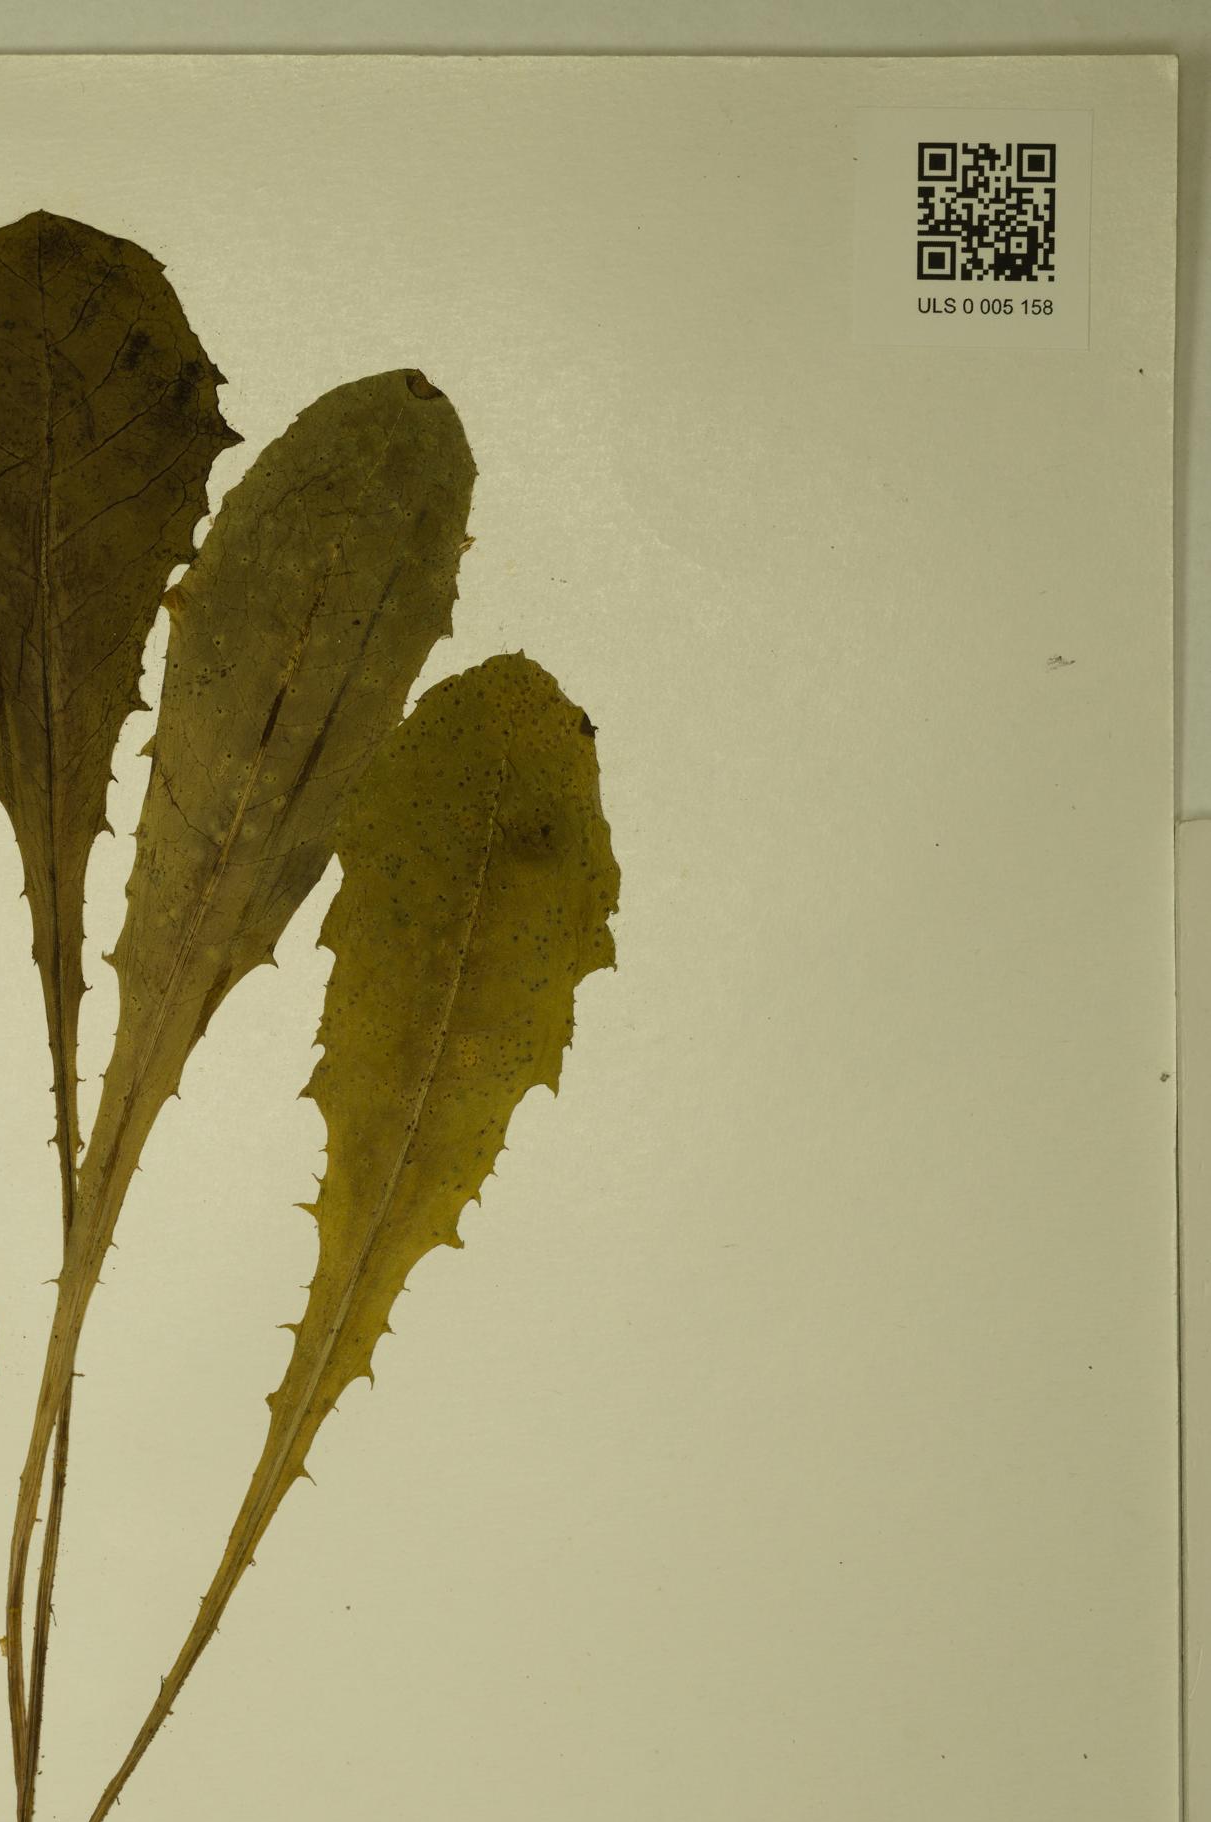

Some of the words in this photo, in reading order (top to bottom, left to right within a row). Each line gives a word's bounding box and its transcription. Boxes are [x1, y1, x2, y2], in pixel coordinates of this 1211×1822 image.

[918, 298, 957, 314] ULS
[962, 298, 974, 315] 0
[980, 299, 1014, 315] 005
[1021, 299, 1054, 316] 158
